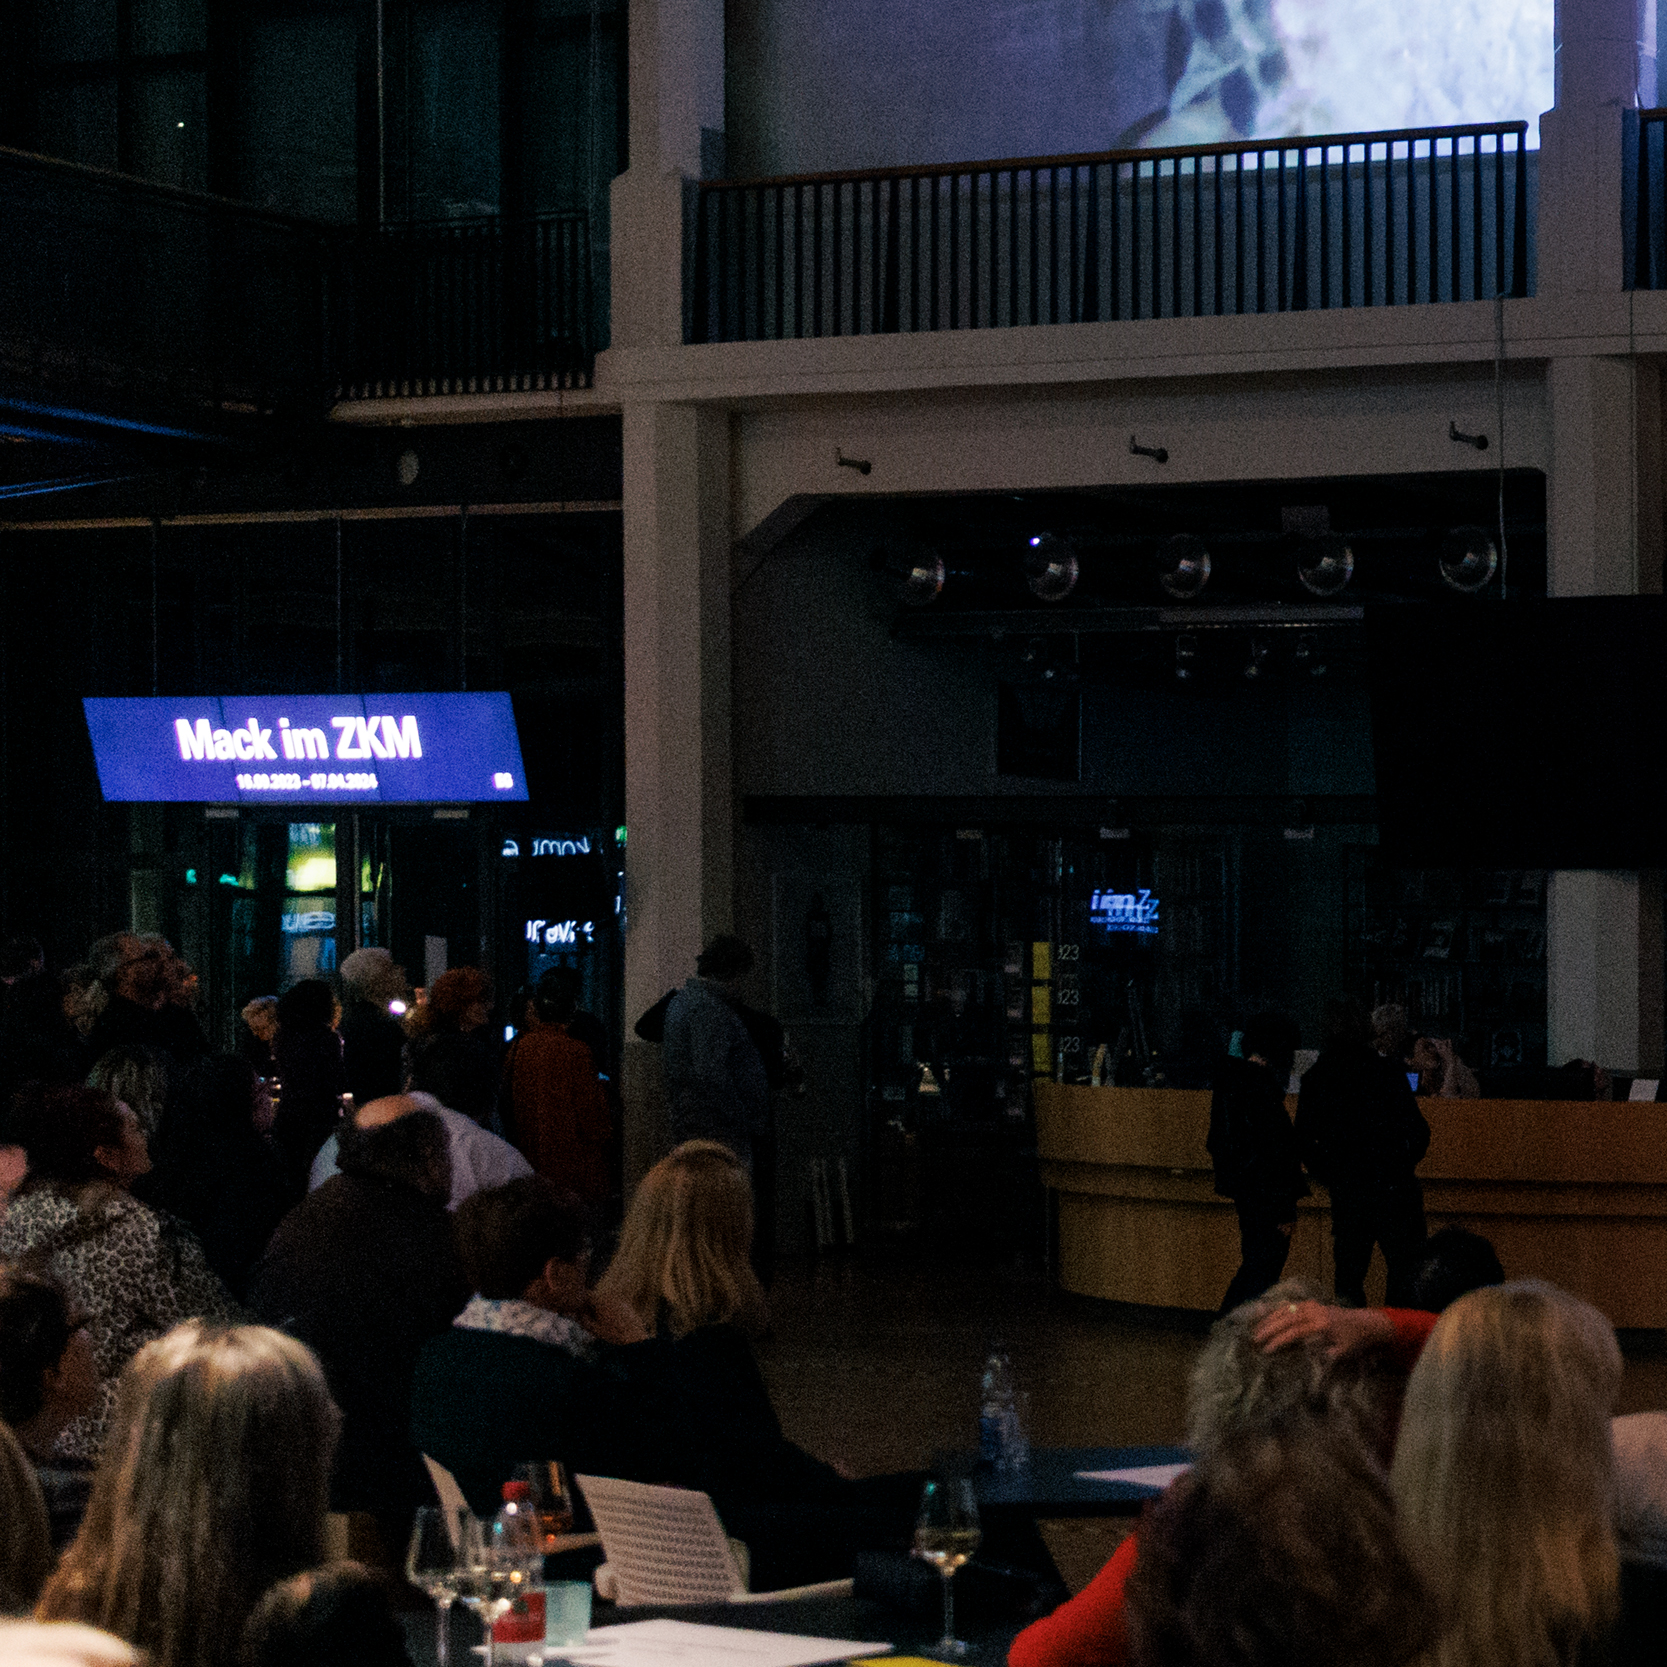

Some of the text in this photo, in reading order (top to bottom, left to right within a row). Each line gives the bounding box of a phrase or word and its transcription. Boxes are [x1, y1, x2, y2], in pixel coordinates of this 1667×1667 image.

[175, 715, 423, 760] Mack im ZKM
